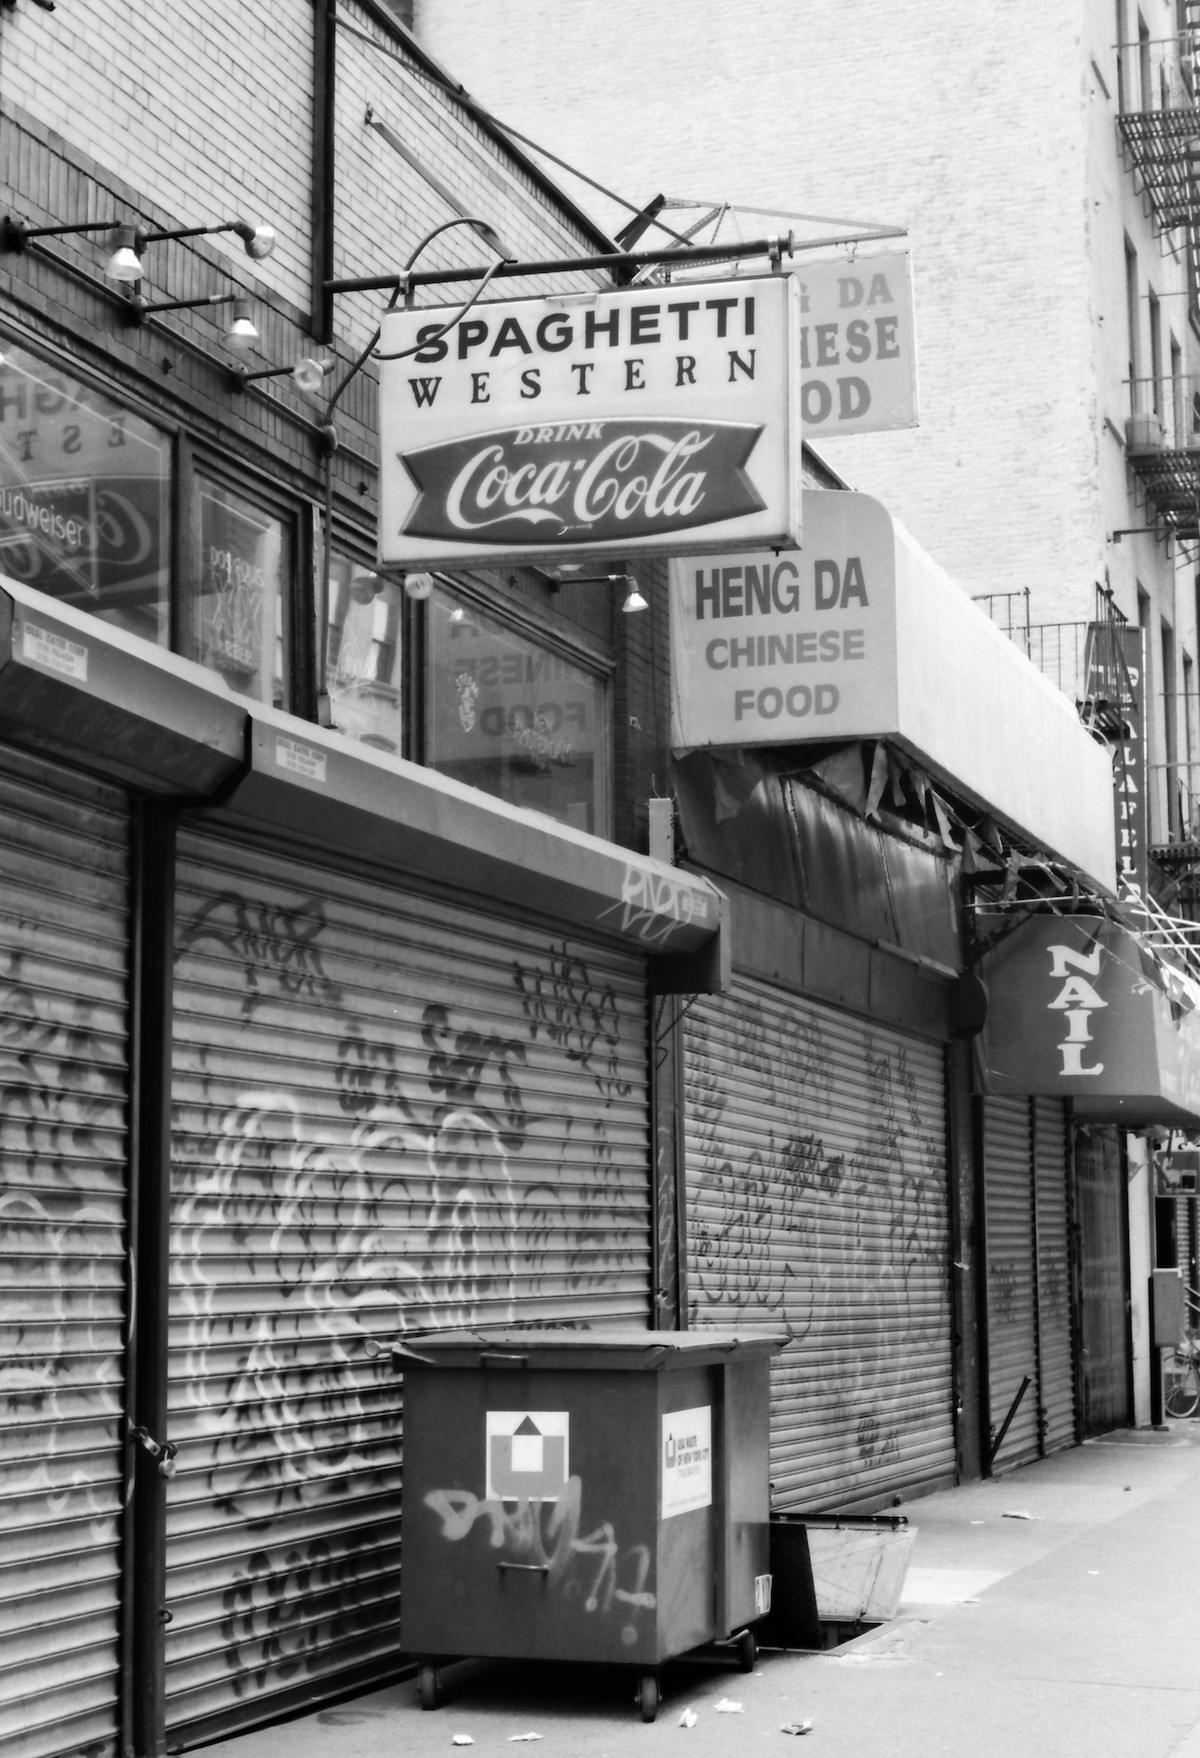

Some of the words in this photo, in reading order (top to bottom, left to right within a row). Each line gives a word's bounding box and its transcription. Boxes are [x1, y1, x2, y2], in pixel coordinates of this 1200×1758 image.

[837, 273, 895, 309] DA
[413, 296, 756, 364] SPAGHETTI
[408, 349, 757, 409] WESTERN
[512, 423, 606, 446] DRINK
[445, 430, 716, 530] Coca-Cola
[0, 490, 83, 548] udweiser
[695, 561, 800, 620] HENG
[814, 556, 870, 611] DA
[705, 629, 865, 671] CHINESE
[734, 683, 841, 721] FOOD
[1046, 944, 1109, 1076] NAIL
